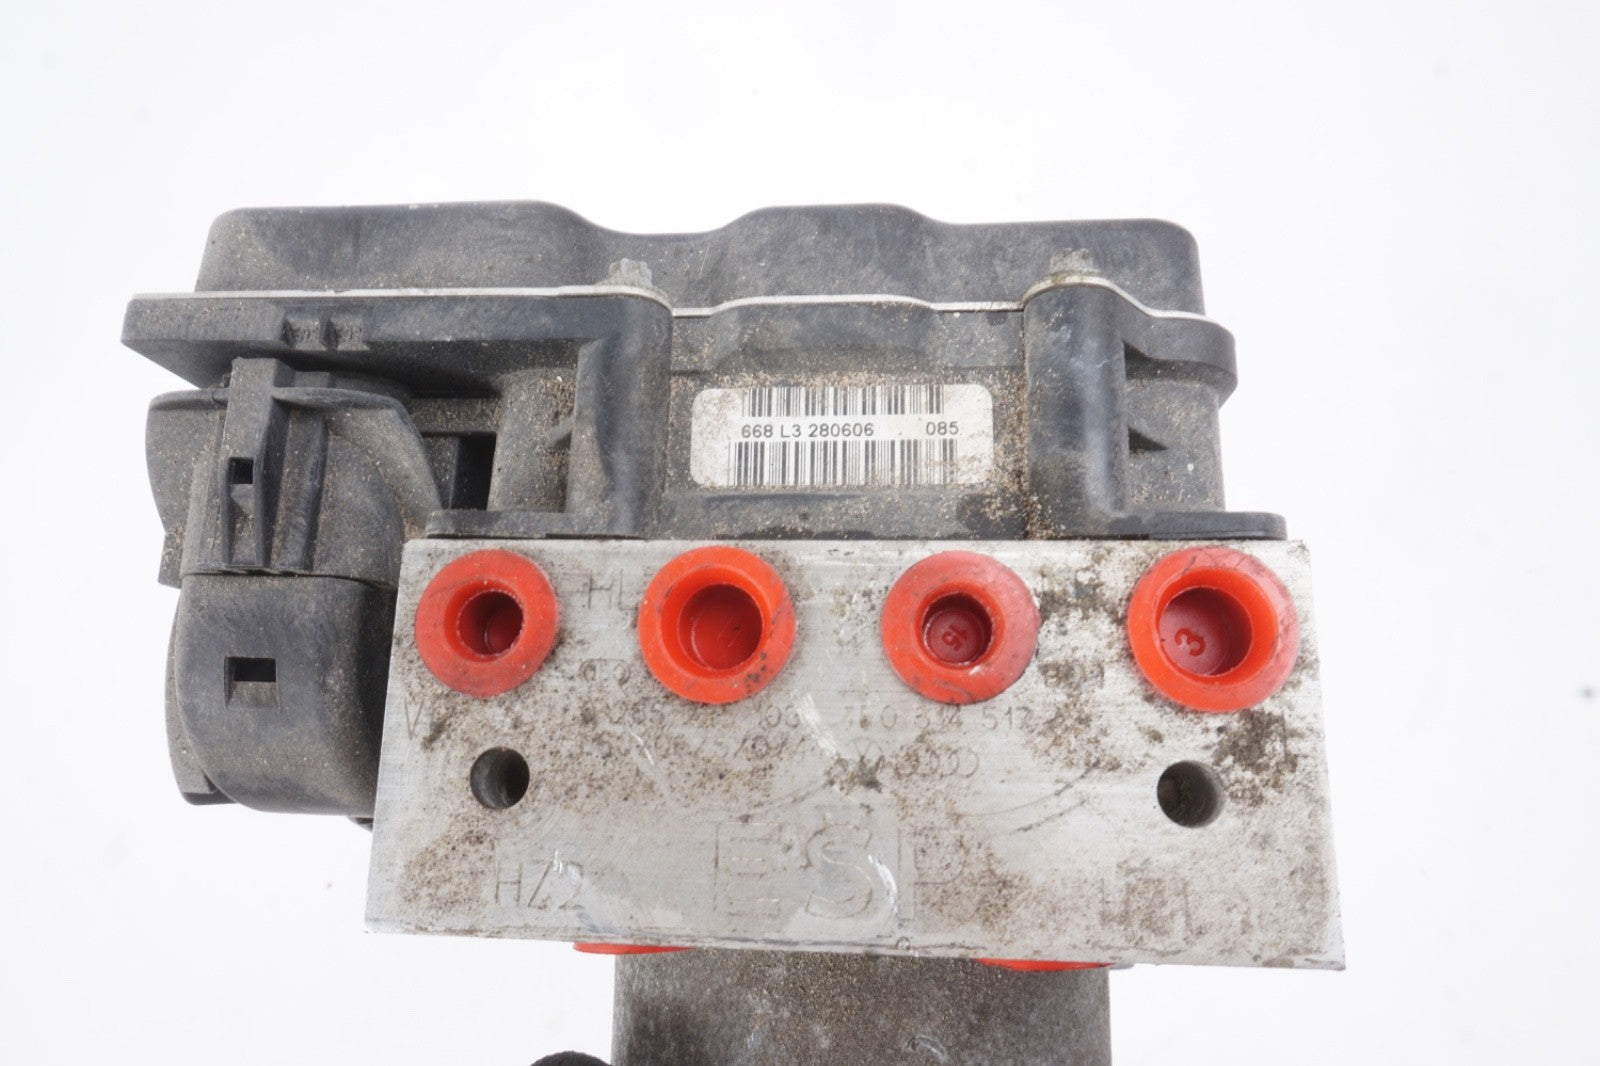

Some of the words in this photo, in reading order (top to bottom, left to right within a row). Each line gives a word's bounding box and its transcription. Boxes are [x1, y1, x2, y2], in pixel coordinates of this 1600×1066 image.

[741, 424, 773, 438] 668
[780, 424, 801, 438] L3
[808, 423, 874, 437] 280606
[926, 421, 959, 435] 085
[1174, 627, 1206, 657] 3
